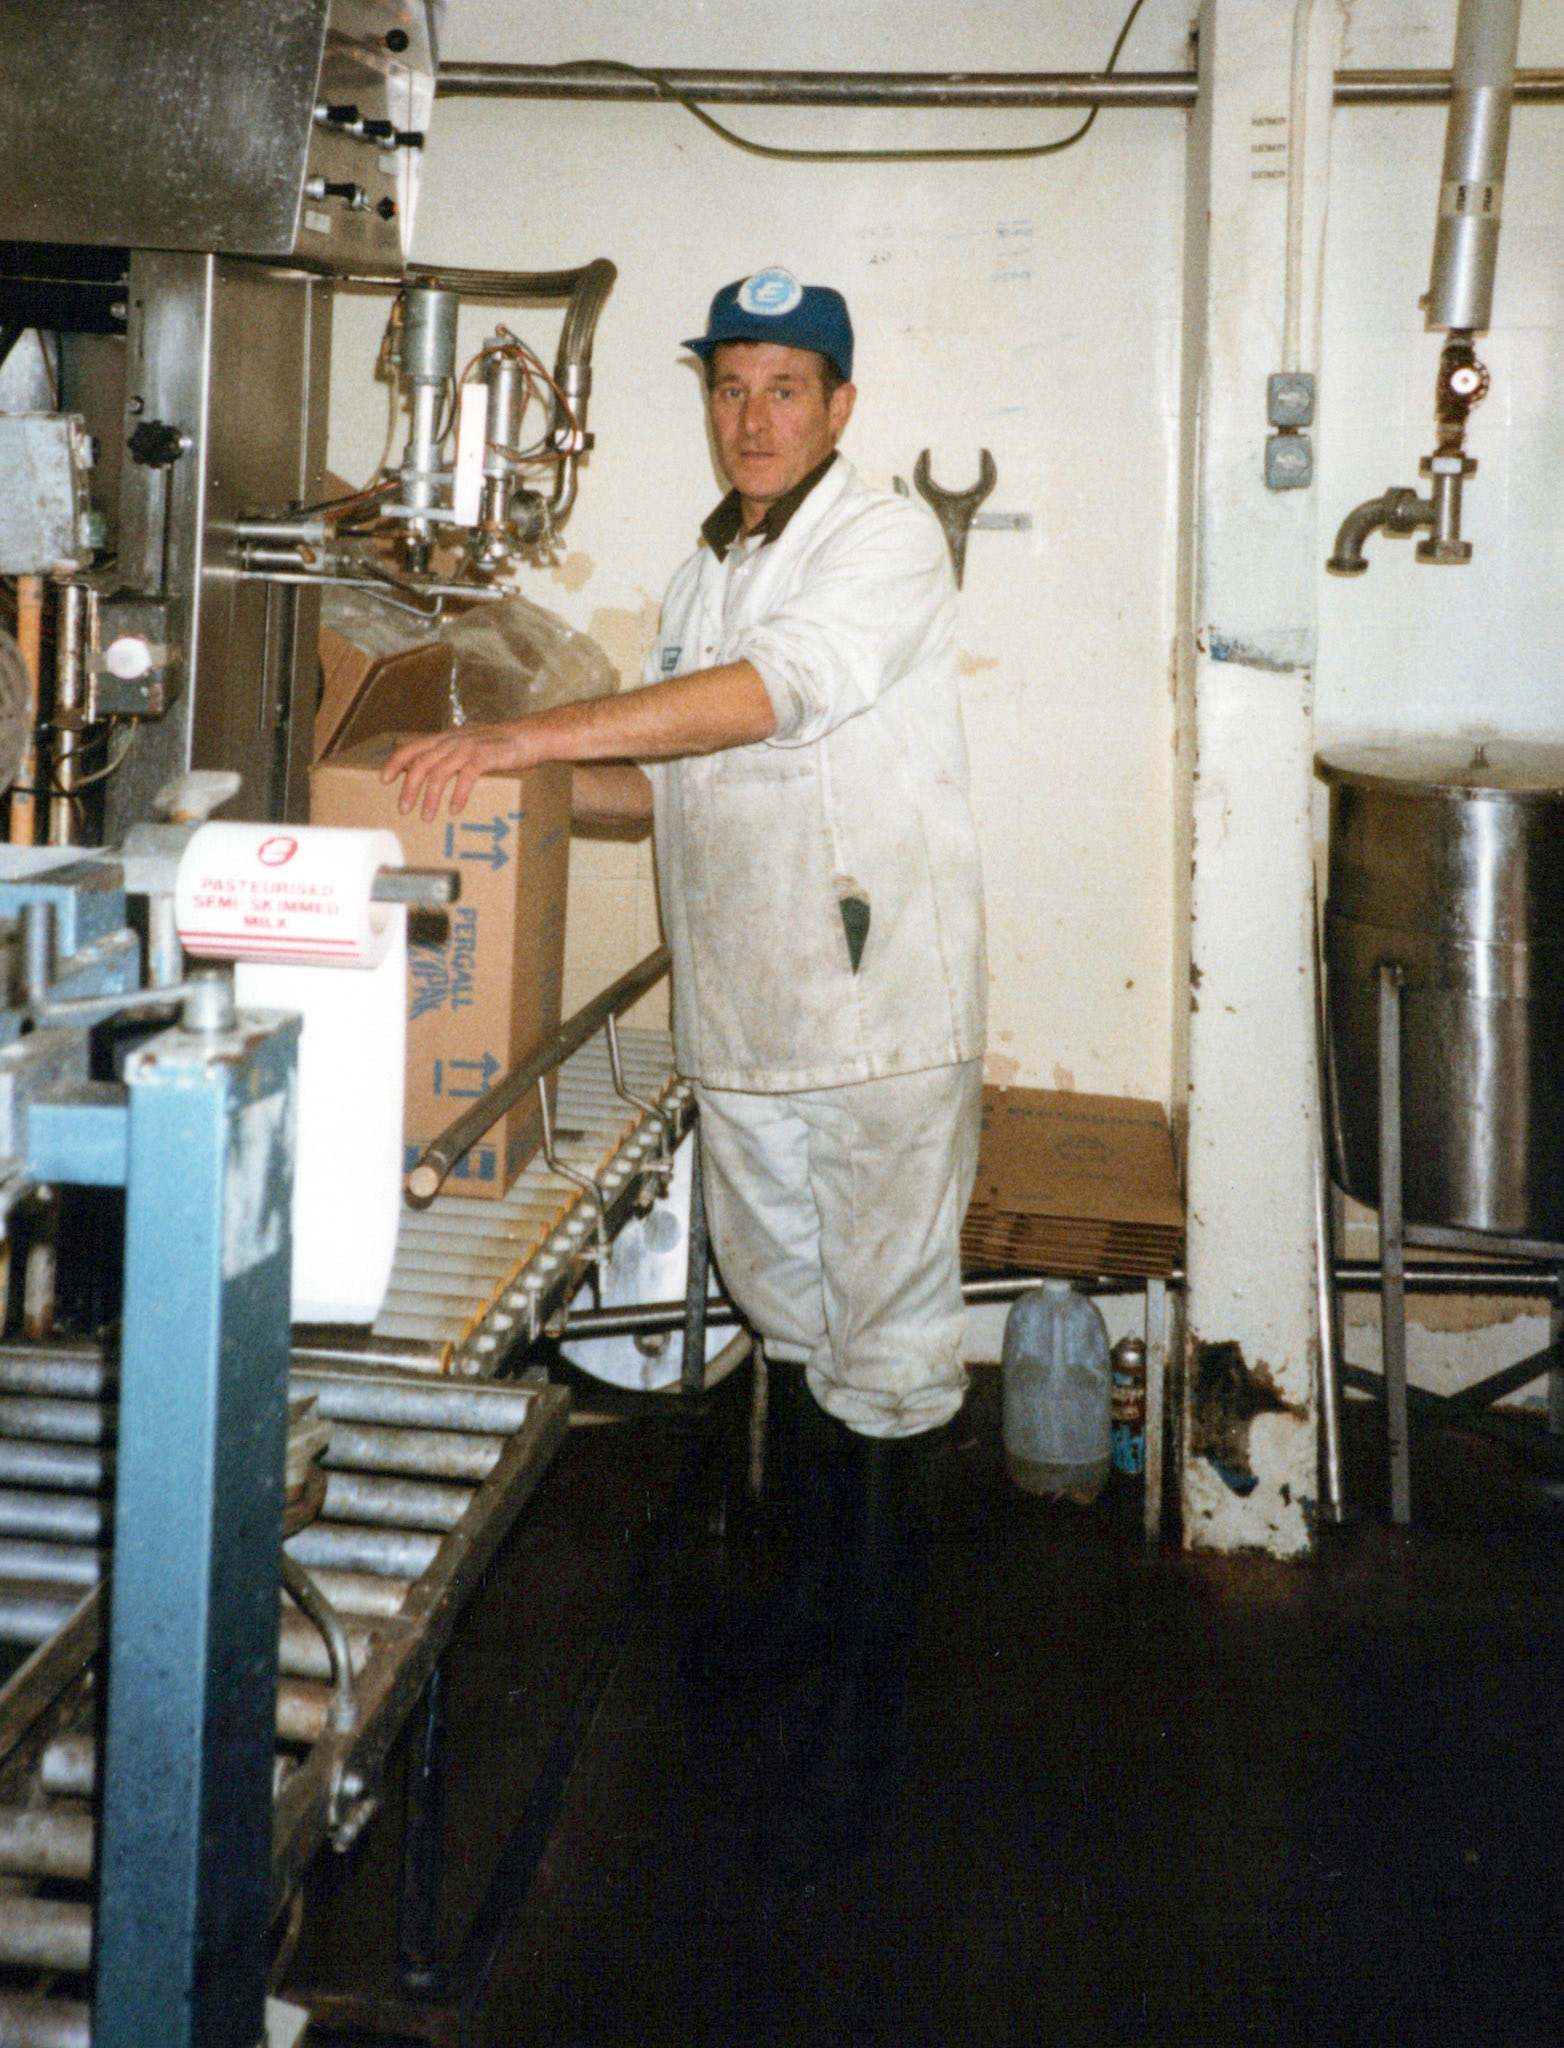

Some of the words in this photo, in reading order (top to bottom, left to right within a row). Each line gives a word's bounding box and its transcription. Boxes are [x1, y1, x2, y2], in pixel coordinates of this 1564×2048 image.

[1456, 185, 1466, 211] STEAM
[1483, 187, 1492, 212] STEAM
[202, 877, 334, 897] PASTEURISED
[243, 915, 288, 928] MILK
[452, 907, 478, 1012] PERGALL
